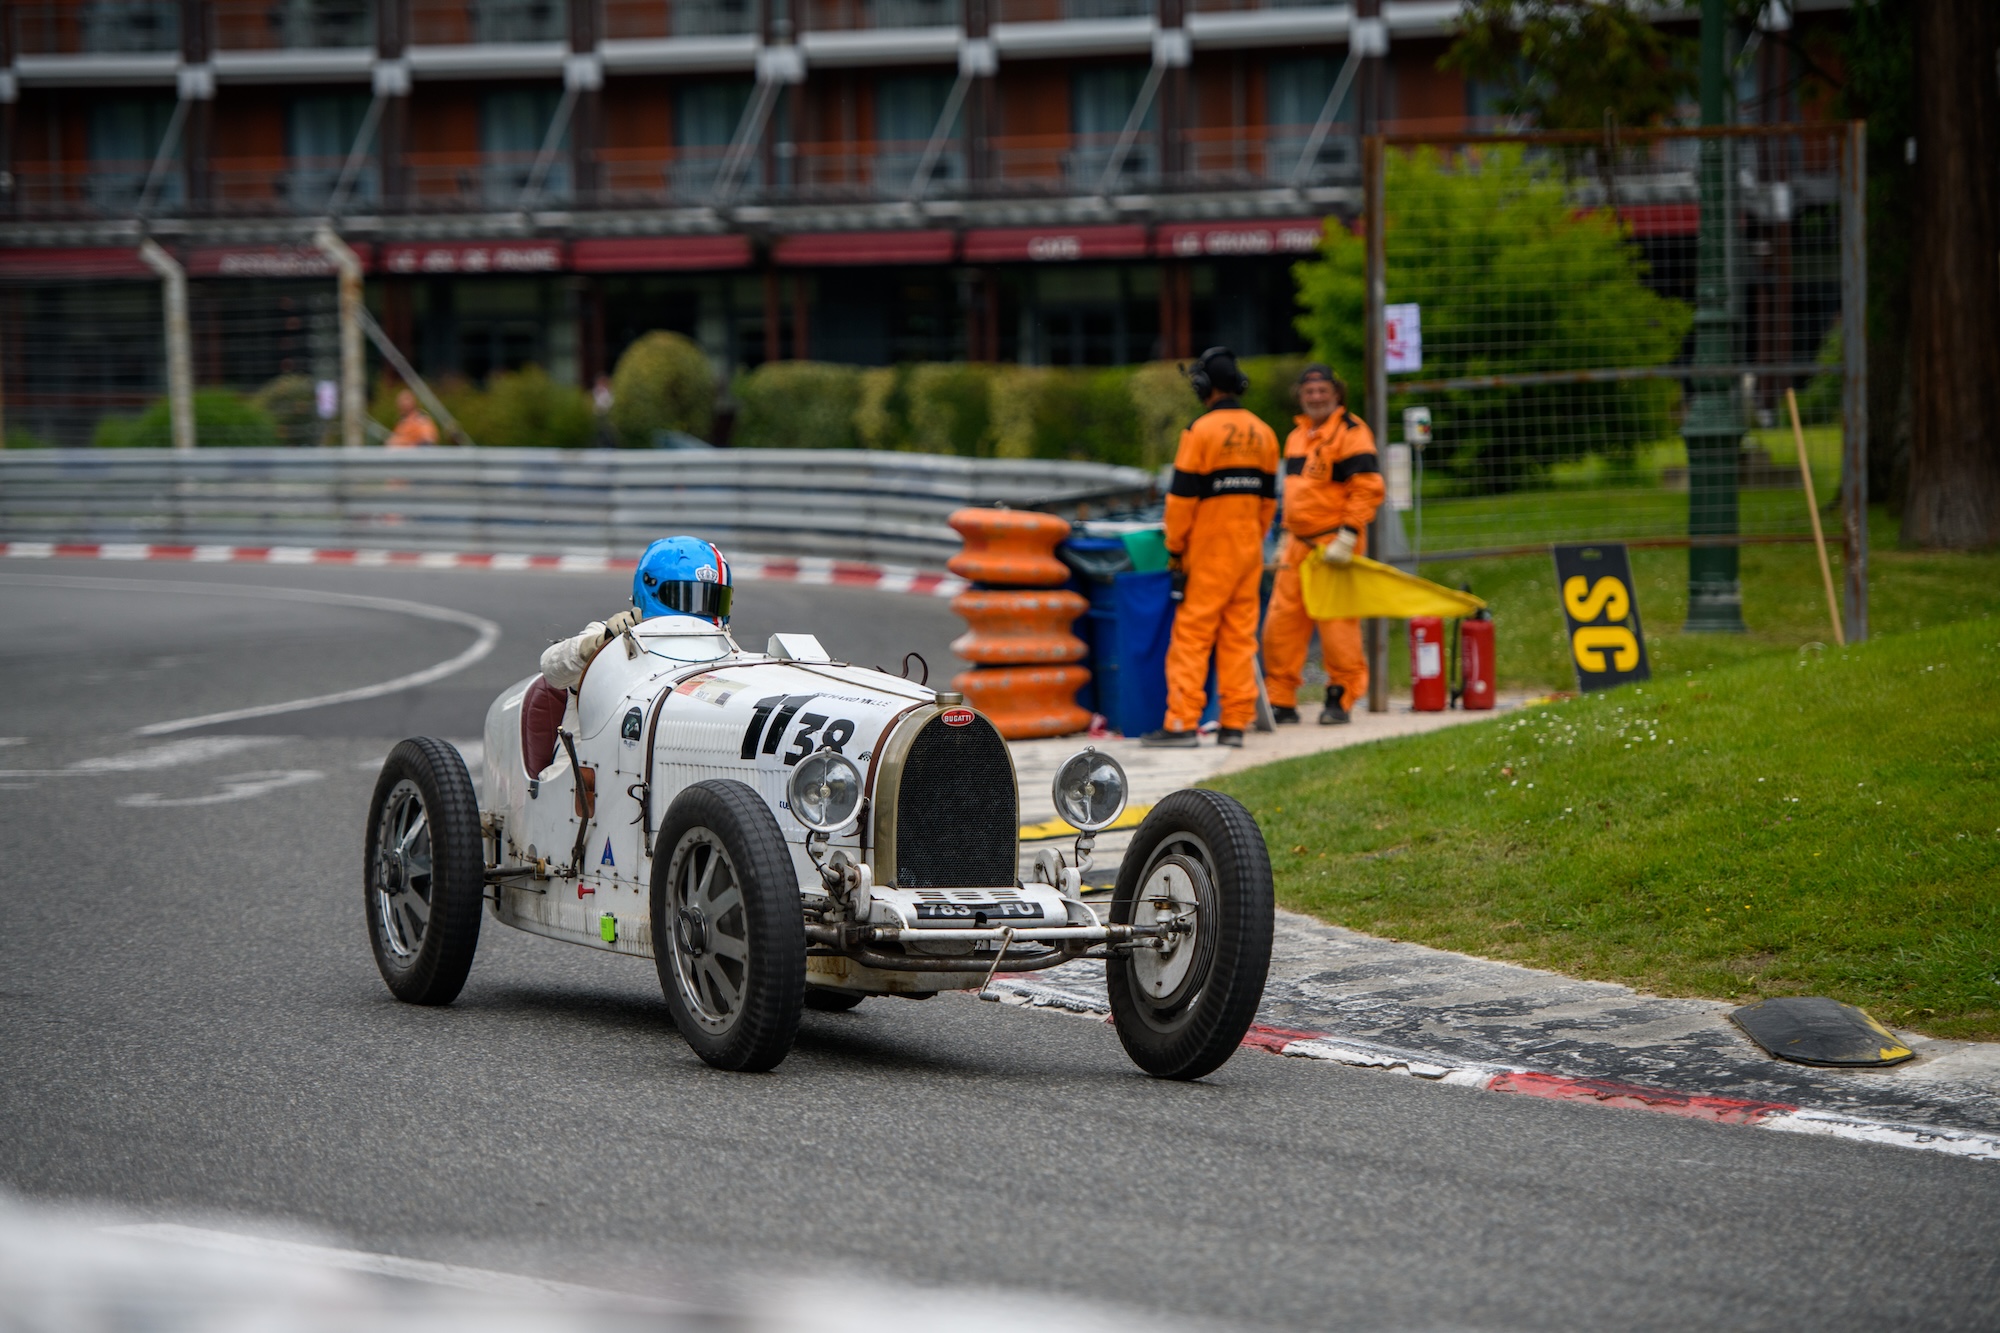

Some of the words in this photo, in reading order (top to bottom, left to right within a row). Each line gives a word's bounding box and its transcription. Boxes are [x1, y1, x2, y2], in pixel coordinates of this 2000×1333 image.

[1206, 232, 1272, 253] GRAND
[1563, 575, 1640, 673] SC
[944, 714, 972, 723] BUGATTI
[923, 904, 971, 916] 783
[1000, 903, 1035, 916] FU
